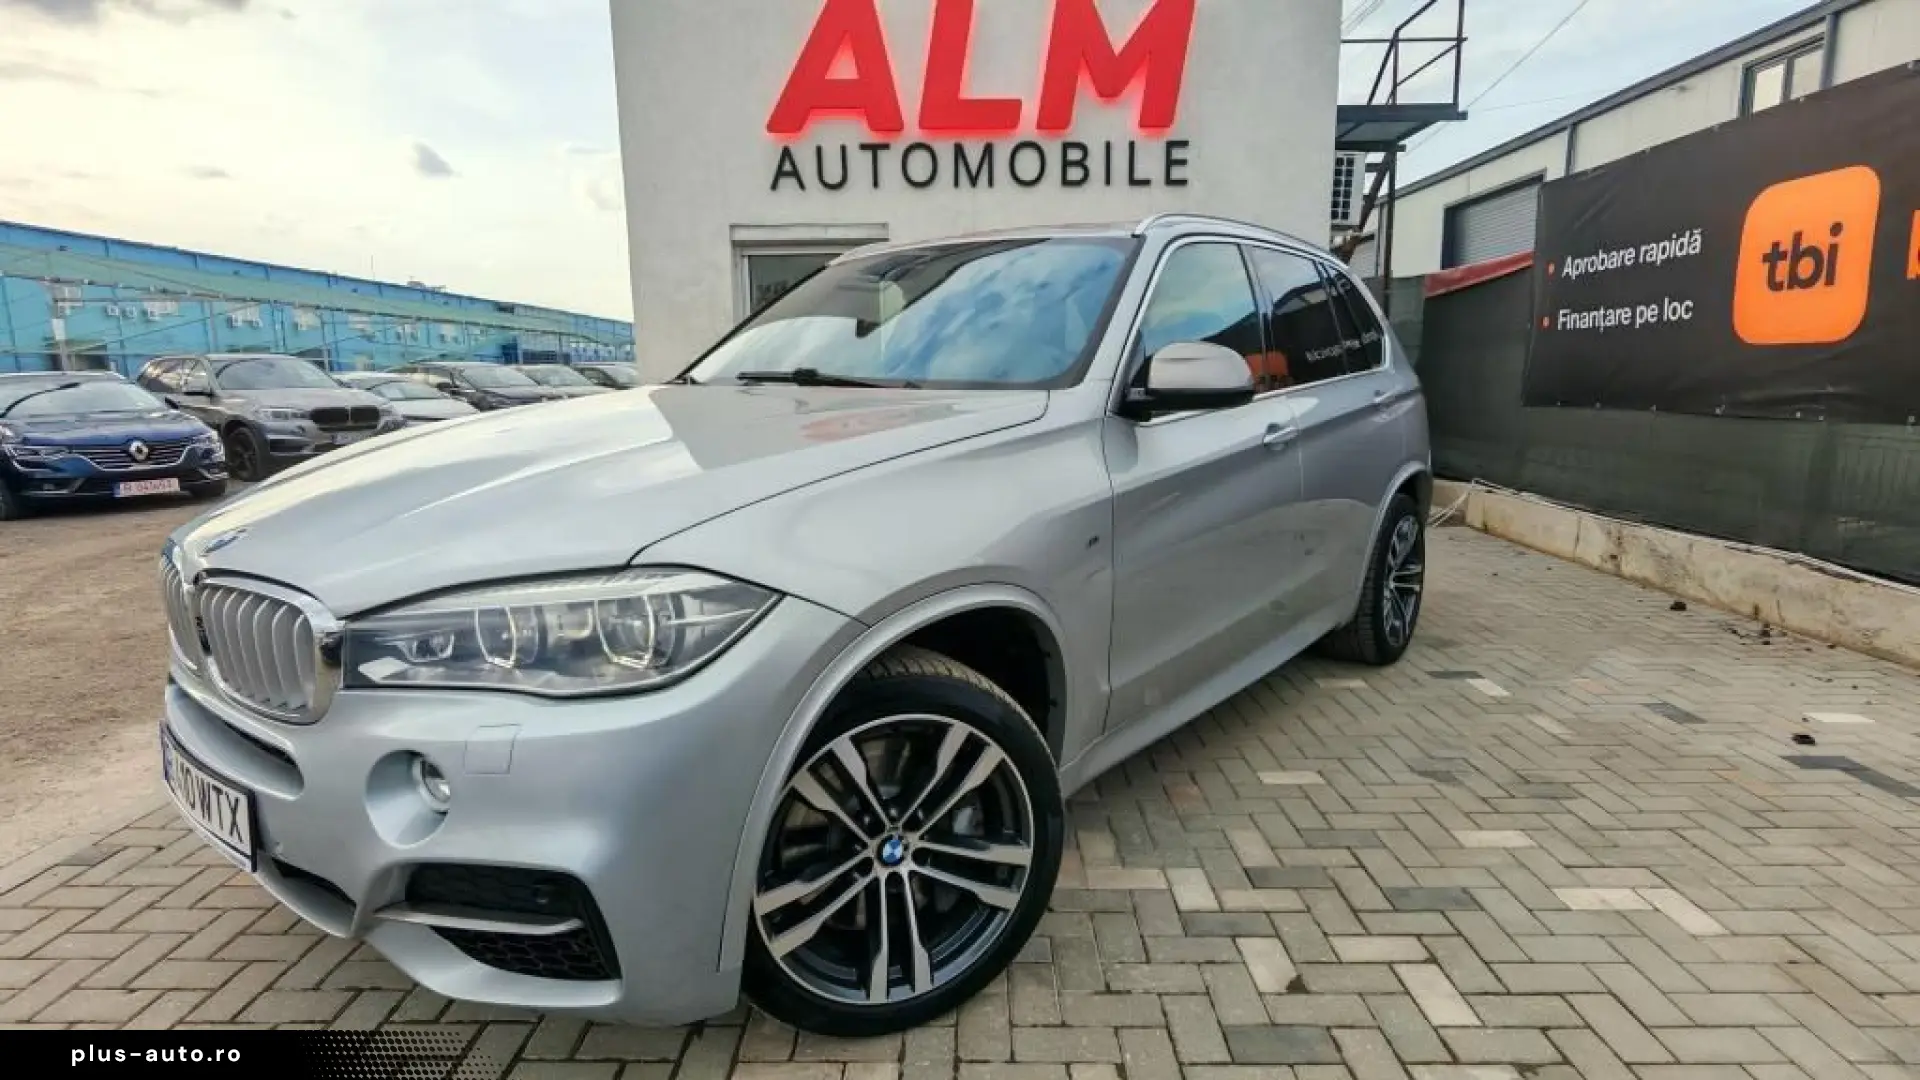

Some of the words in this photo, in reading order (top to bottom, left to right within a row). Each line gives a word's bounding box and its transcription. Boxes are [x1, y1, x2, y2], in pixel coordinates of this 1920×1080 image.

[766, 0, 1196, 134] ALM
[770, 140, 1190, 191] AUTOMOBILE
[1561, 246, 1636, 280] Aprobare
[1639, 227, 1703, 266] rapidă
[1761, 222, 1844, 292] tbi
[1557, 304, 1632, 334] Finanțare
[1635, 303, 1659, 329] pe
[1662, 296, 1694, 322] loc
